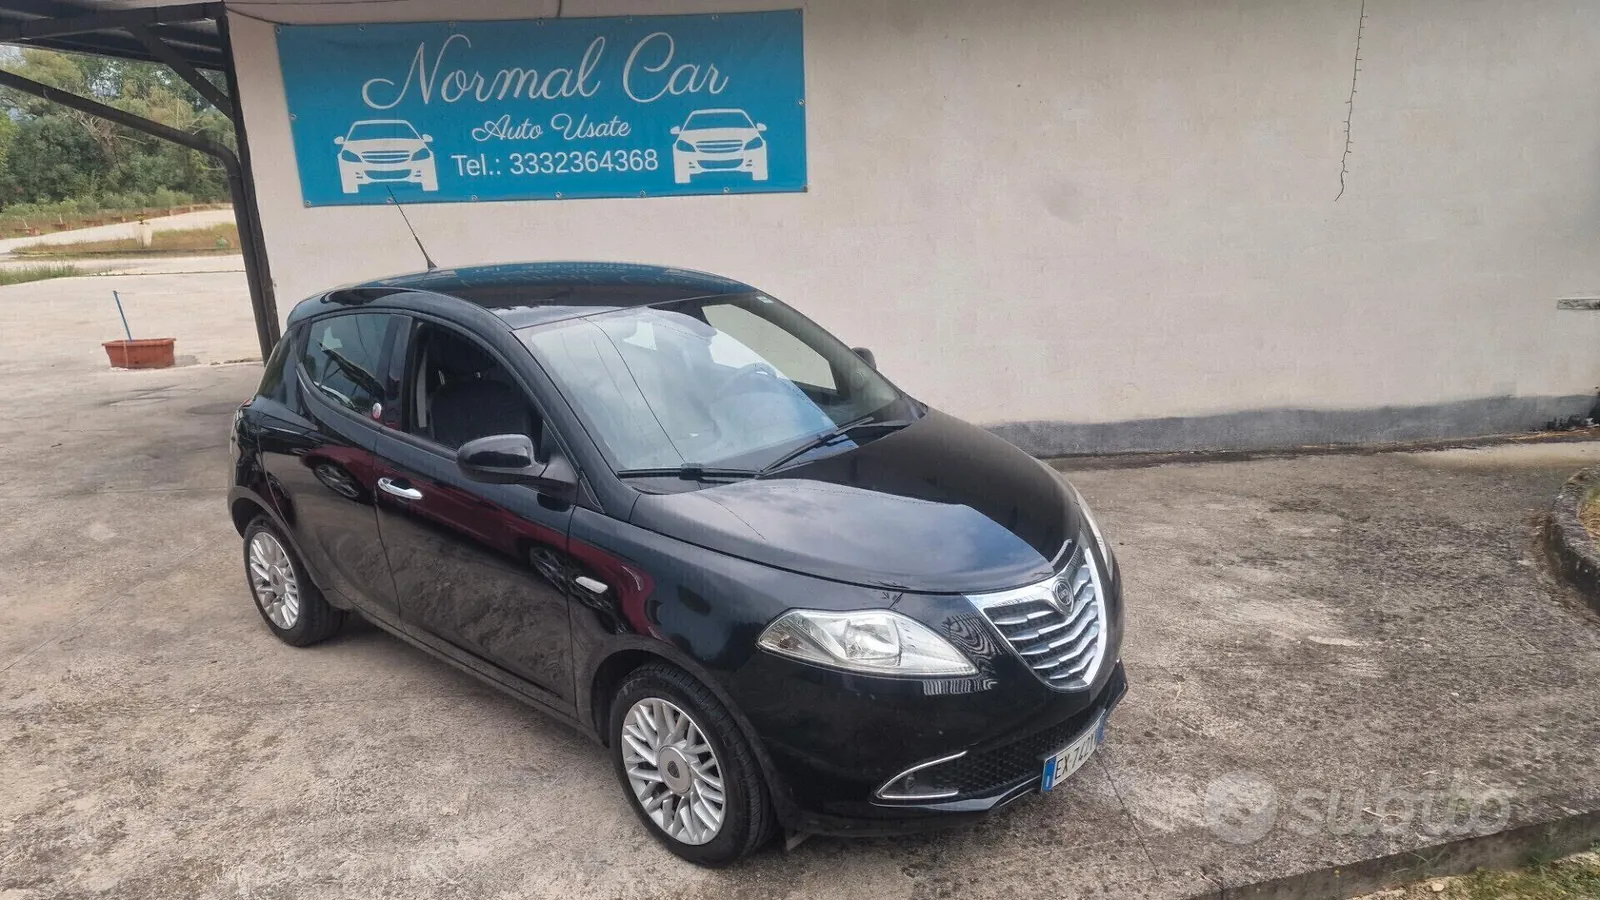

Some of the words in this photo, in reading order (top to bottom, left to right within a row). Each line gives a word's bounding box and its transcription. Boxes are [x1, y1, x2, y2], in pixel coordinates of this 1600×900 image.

[361, 33, 605, 109] Normal
[622, 31, 729, 103] Car
[471, 114, 544, 142] Auto
[551, 113, 631, 140] Usate
[451, 153, 501, 176] Tel.:
[509, 148, 659, 175] 3332364368
